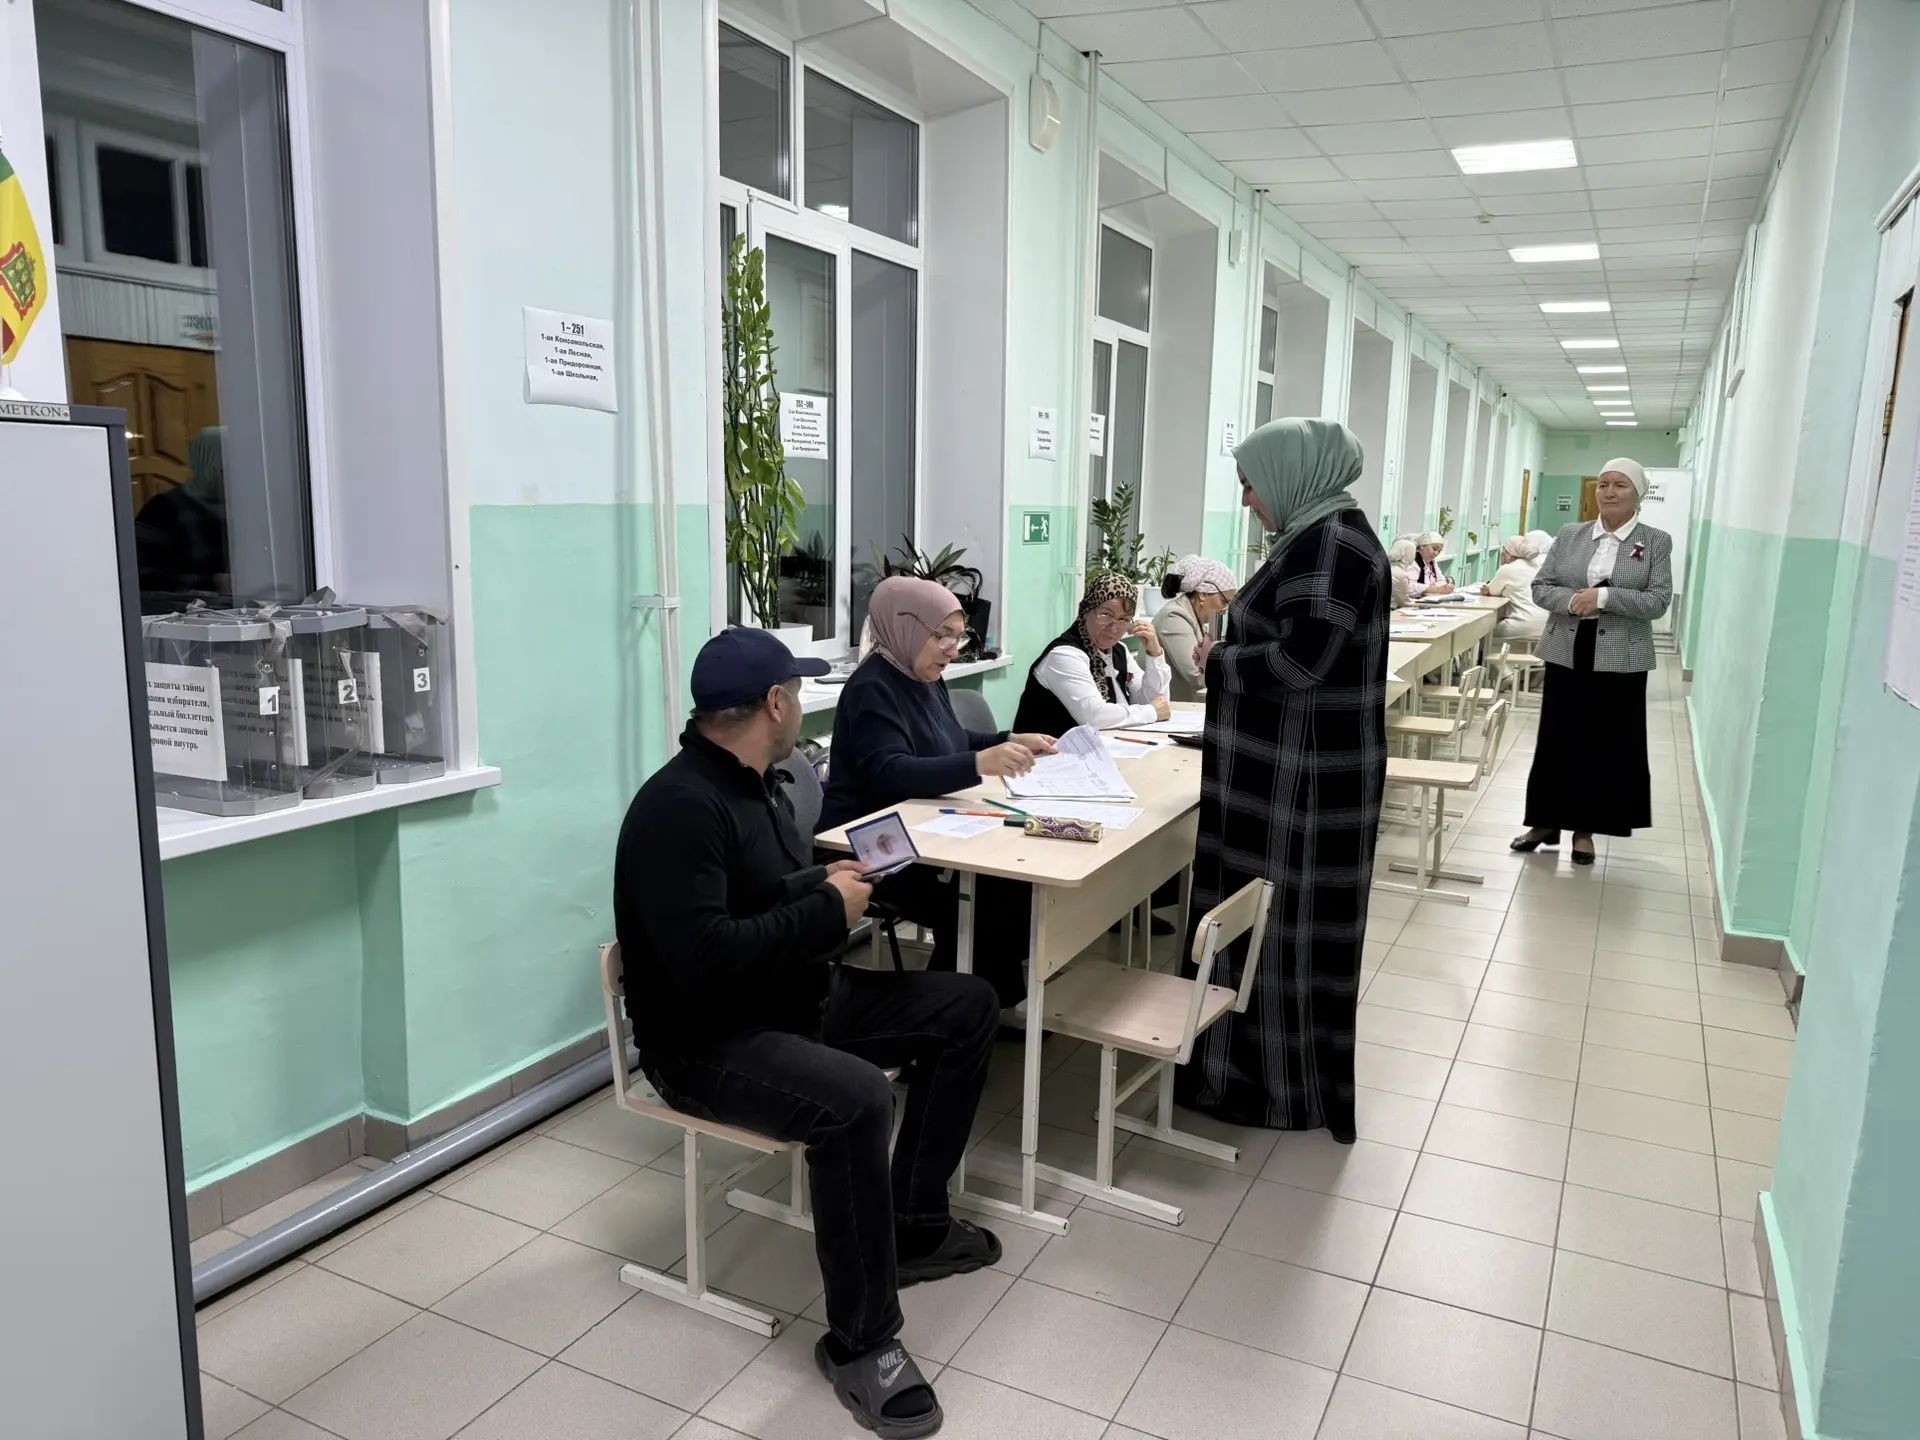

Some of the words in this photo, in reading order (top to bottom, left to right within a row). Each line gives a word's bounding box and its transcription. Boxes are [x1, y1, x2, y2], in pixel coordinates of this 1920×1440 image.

[541, 333, 554, 341] 1-ая
[555, 335, 605, 351] Комсомольская,
[554, 346, 567, 355] 1-ая
[568, 348, 593, 360] Лесная,
[545, 356, 558, 364] 1-ая
[559, 358, 603, 371] Придорожная,
[551, 368, 565, 377] 1-ая
[565, 370, 598, 382] Школьная,
[0, 403, 61, 417] METKON
[153, 681, 181, 690] защиты
[182, 683, 205, 692] тайны
[417, 672, 428, 688] 3
[342, 684, 355, 702] 2
[267, 694, 277, 712] 1
[149, 709, 175, 718] ельный
[176, 709, 215, 723] бюллетень
[877, 1348, 904, 1370] NIKE
